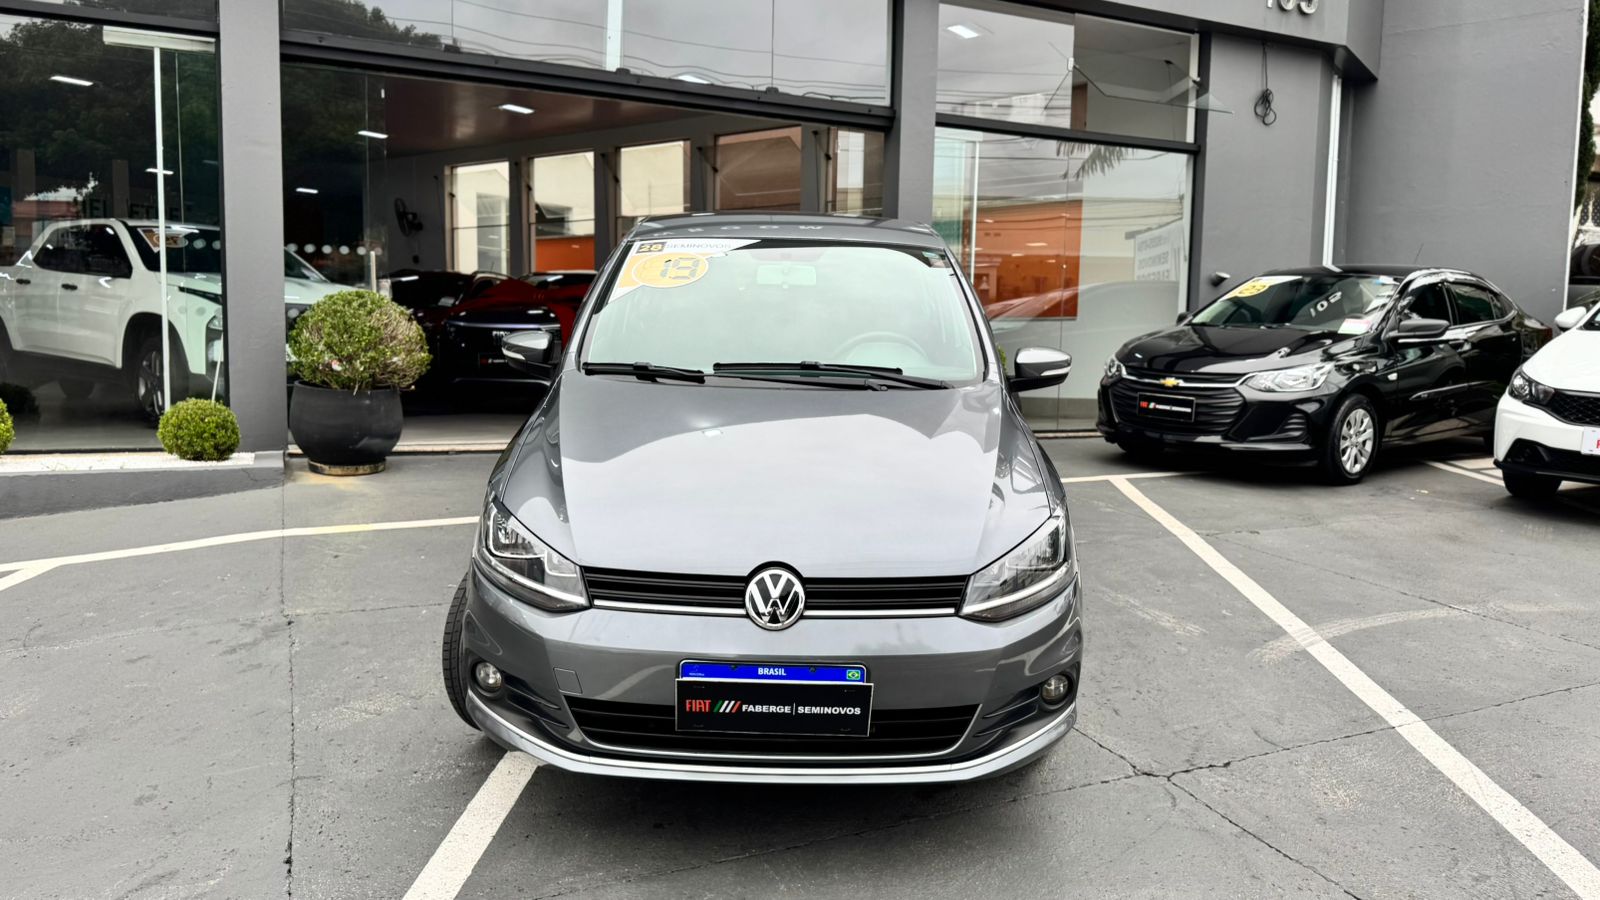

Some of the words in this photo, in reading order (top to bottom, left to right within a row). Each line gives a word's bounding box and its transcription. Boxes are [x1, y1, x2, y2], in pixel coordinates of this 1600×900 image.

[745, 567, 805, 630] VW
[757, 667, 787, 676] BRASIL
[685, 699, 712, 713] FIAT
[742, 704, 792, 714] FABERGE
[797, 706, 861, 715] SEMINOVOS
